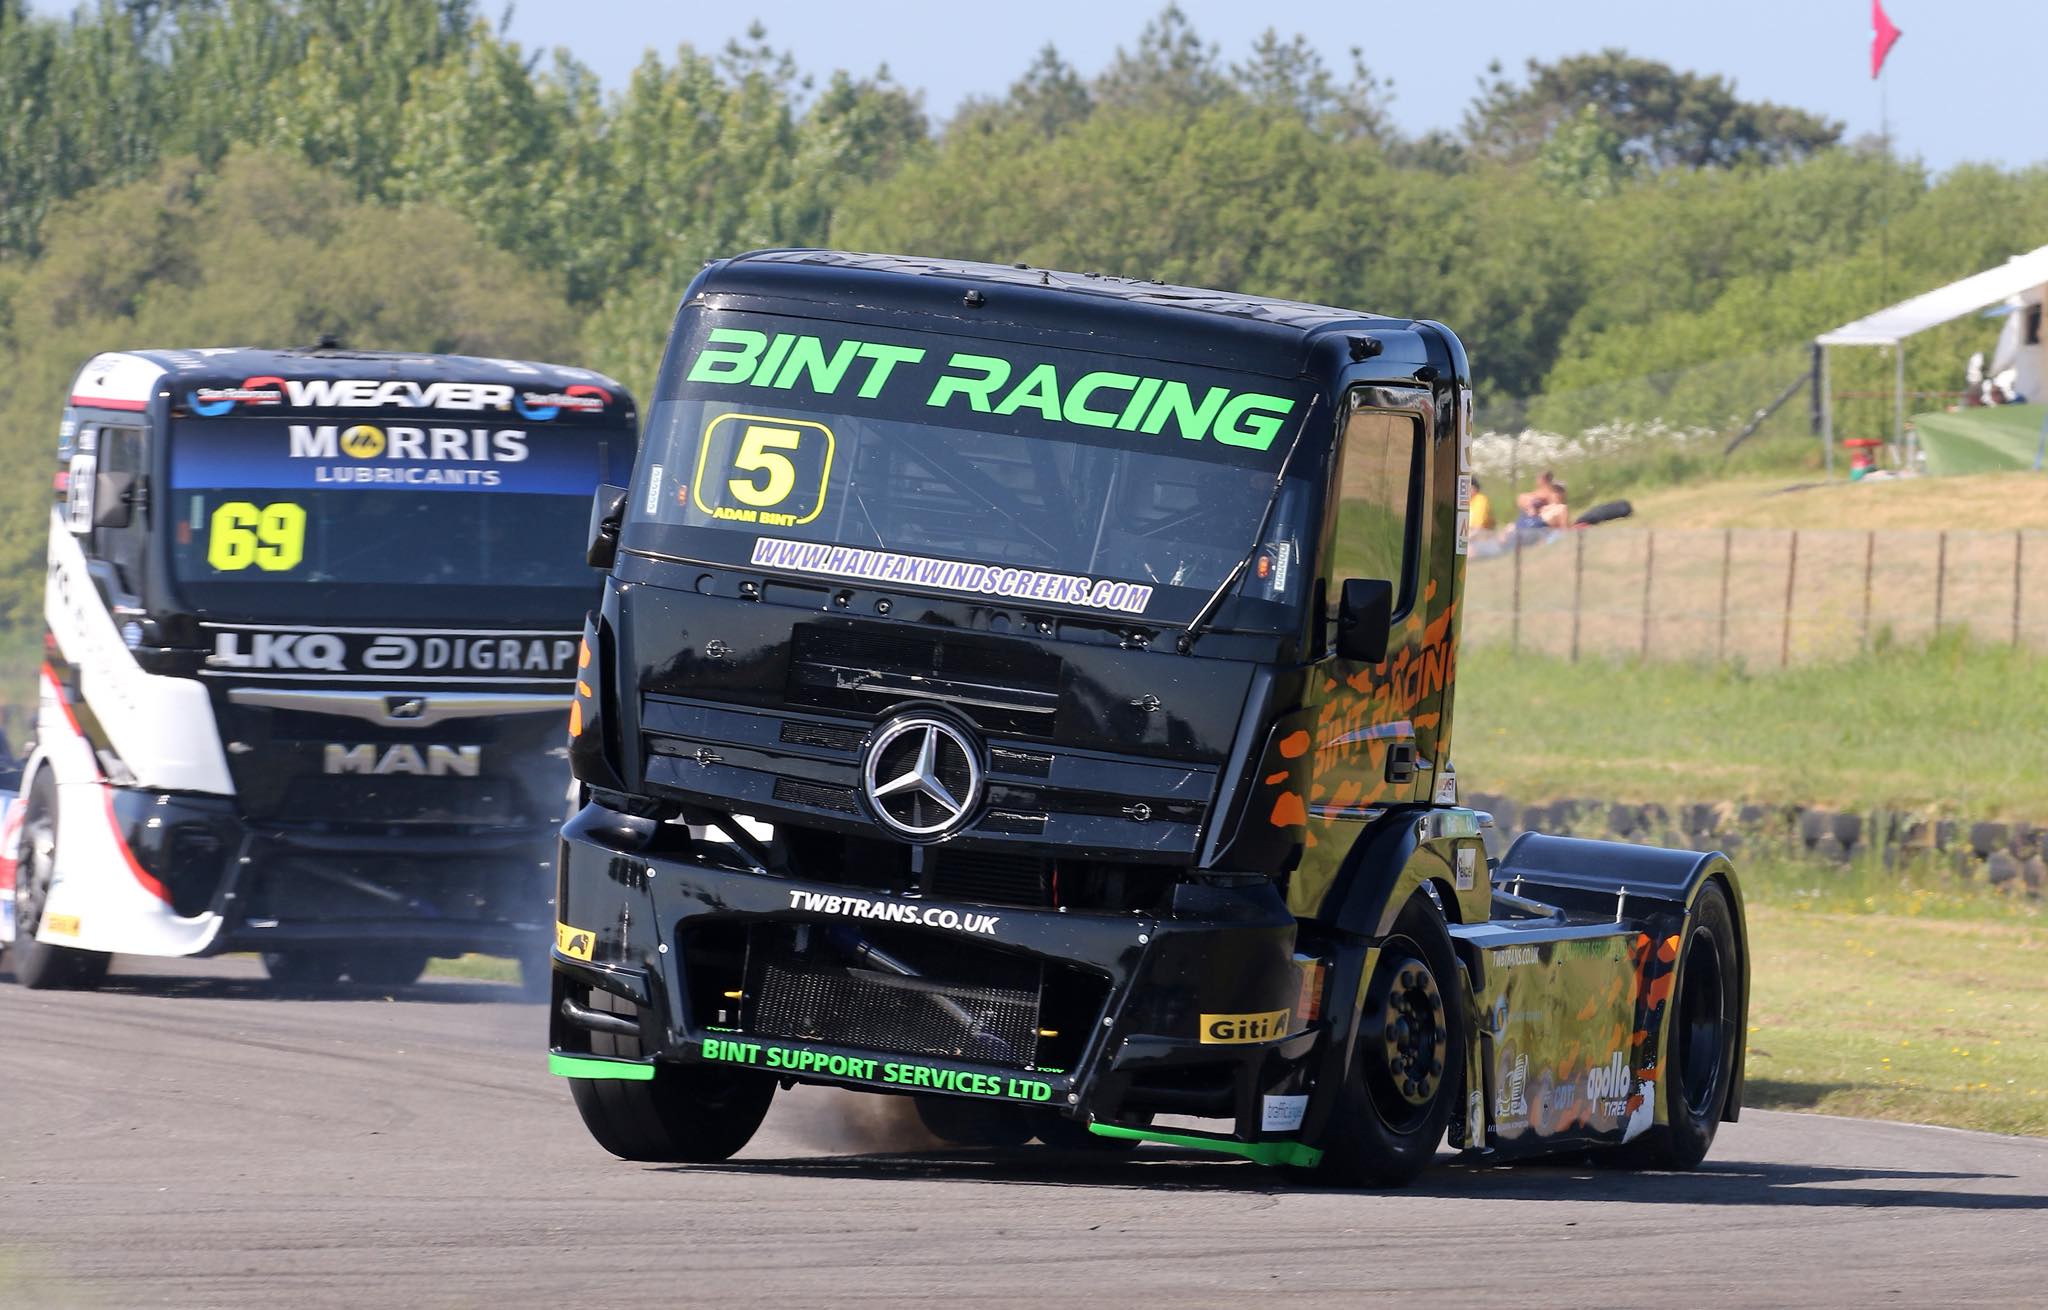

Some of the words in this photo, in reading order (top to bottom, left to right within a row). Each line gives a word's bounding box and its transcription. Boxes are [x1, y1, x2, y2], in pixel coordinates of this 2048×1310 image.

[285, 380, 514, 411] WEAVER
[688, 328, 926, 399] BINT
[926, 353, 1295, 451] RACING
[288, 425, 529, 462] MORRIS
[315, 466, 501, 486] LUBRICANTS
[728, 425, 801, 507] 5
[208, 501, 307, 571] 69
[712, 507, 757, 523] ADAM
[759, 511, 797, 527] BINT
[753, 538, 1153, 613] WWW.HALIFAXWINDSCREENS.COM
[214, 633, 347, 671] LKQ
[423, 638, 576, 670] DIGRAP
[324, 743, 480, 776] MAN
[789, 890, 1000, 935] TWBTRANS.CO.UK
[1209, 1018, 1268, 1040] Giti
[702, 1038, 761, 1064] BINT
[766, 1047, 878, 1080] SUPPORT
[884, 1063, 1001, 1096] SERVICES
[1008, 1078, 1052, 1102] LTD
[1587, 1051, 1631, 1114] apollo
[1603, 1100, 1627, 1117] TYRES
